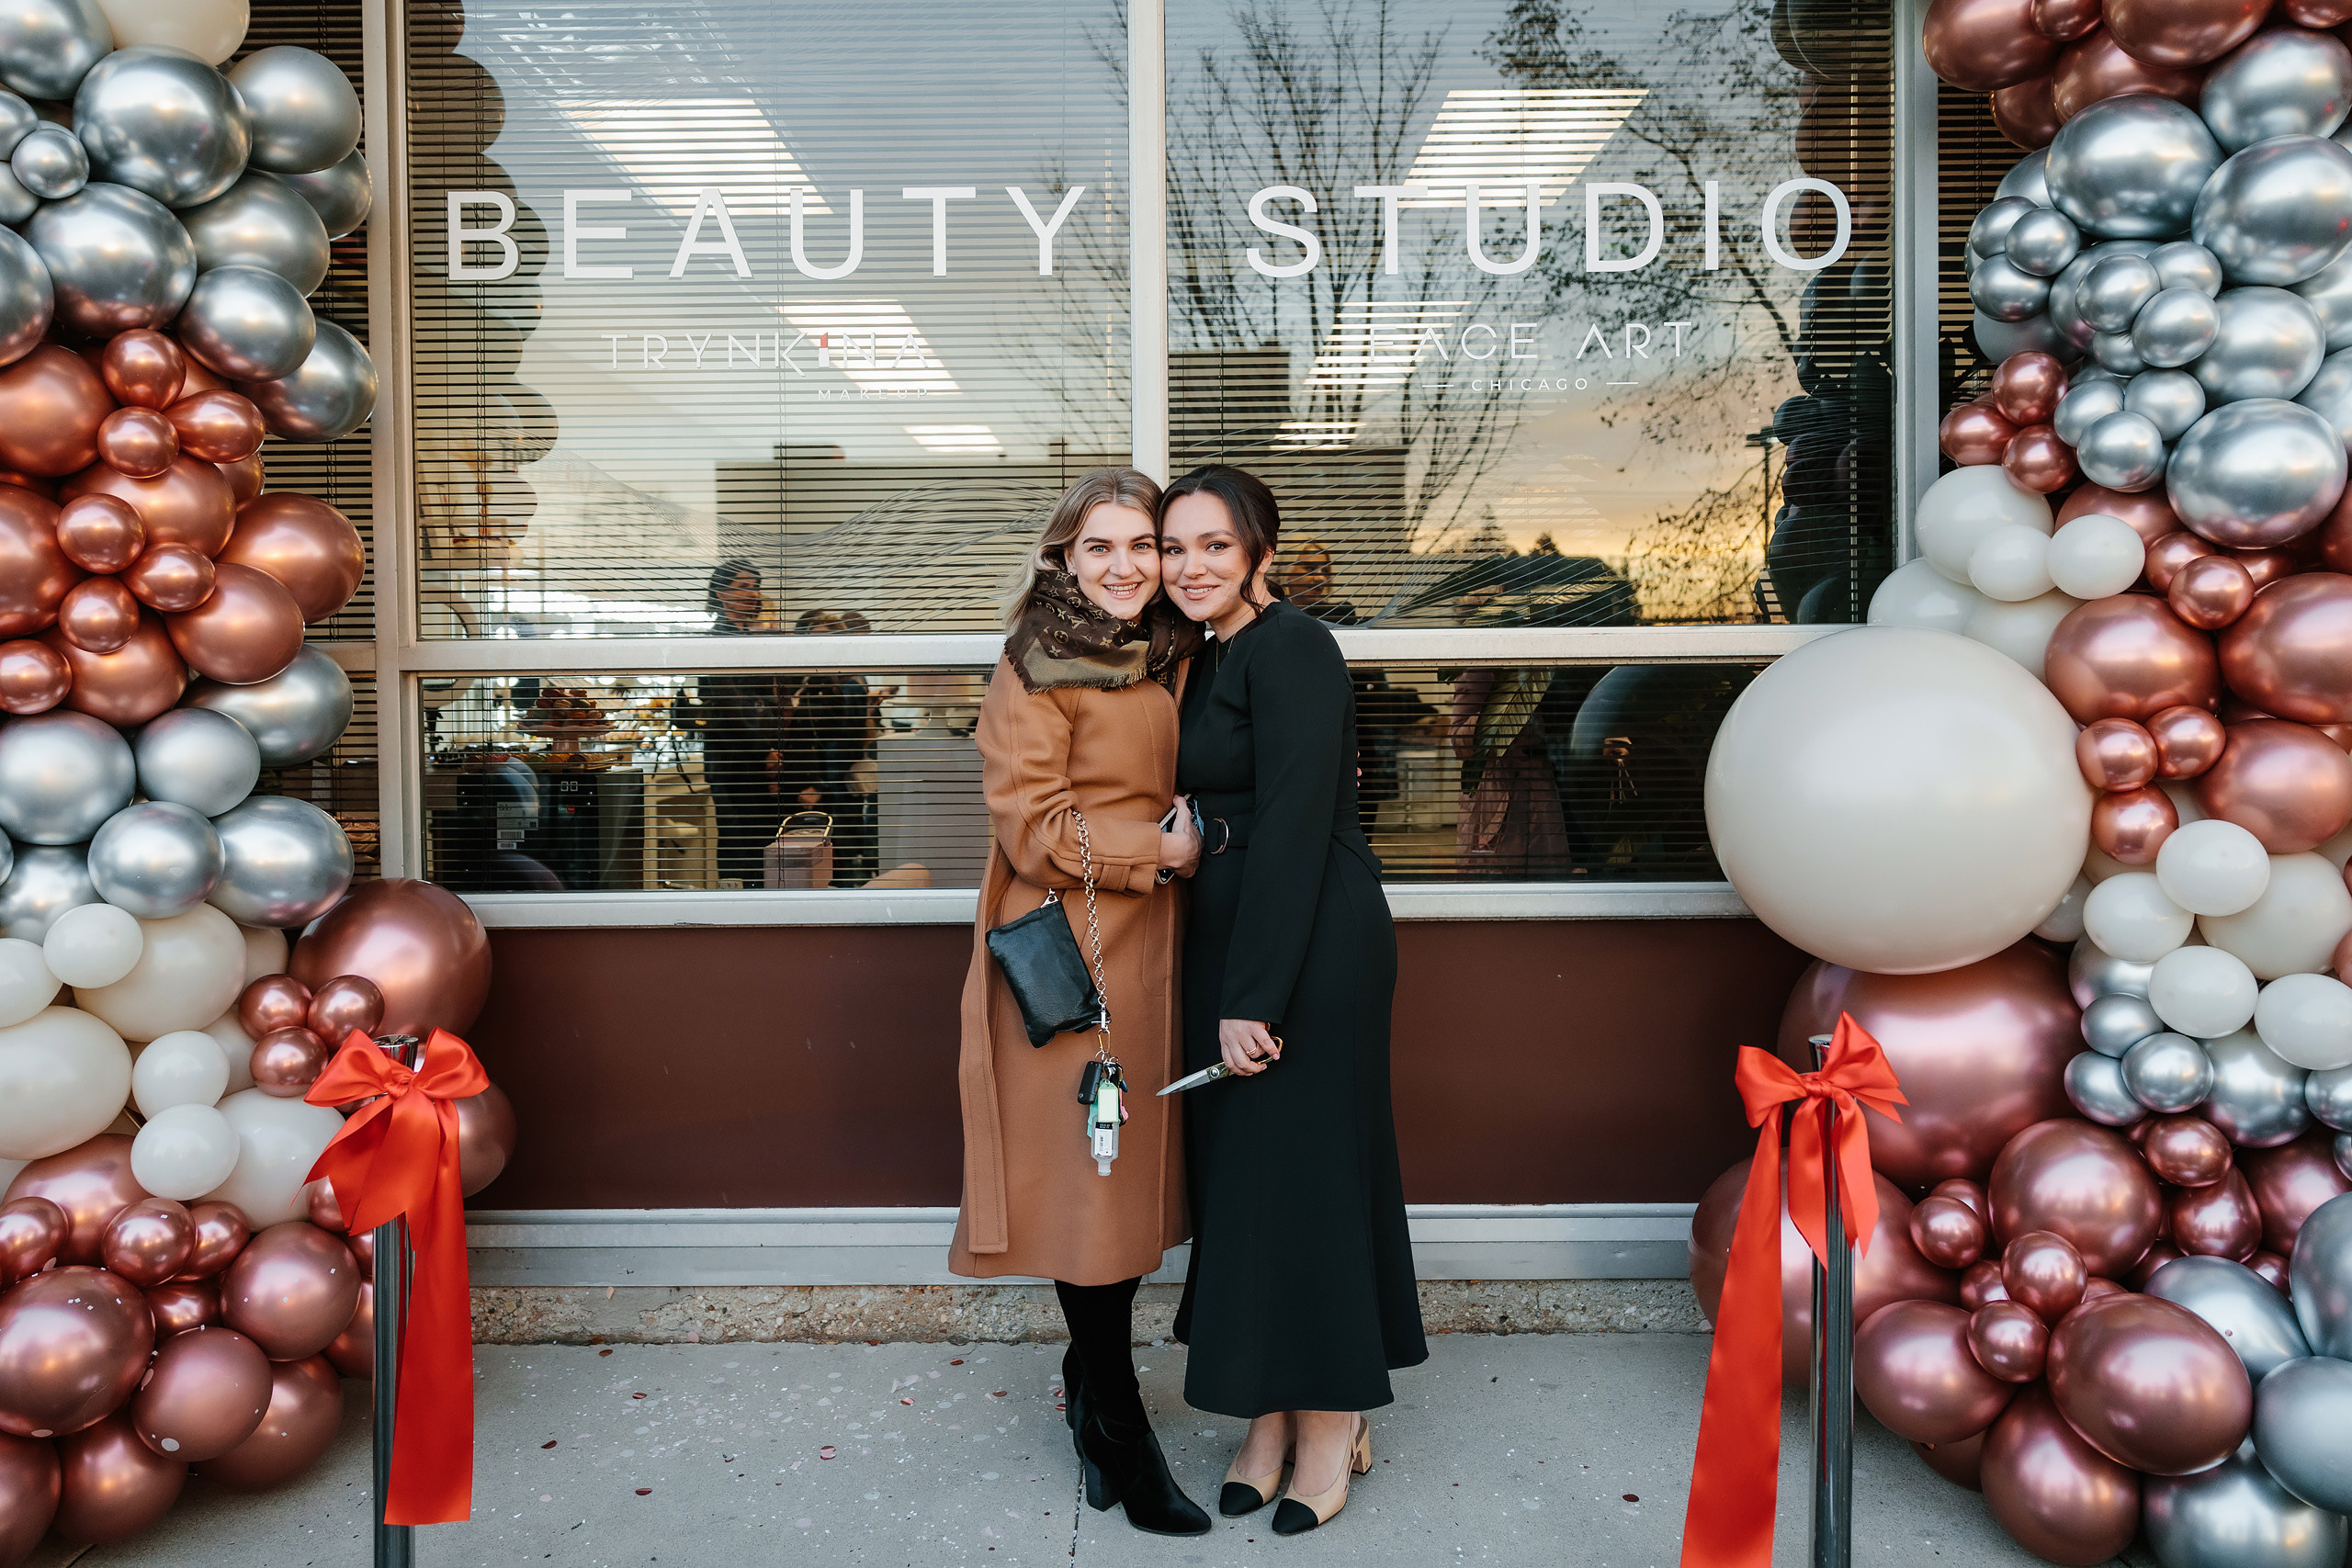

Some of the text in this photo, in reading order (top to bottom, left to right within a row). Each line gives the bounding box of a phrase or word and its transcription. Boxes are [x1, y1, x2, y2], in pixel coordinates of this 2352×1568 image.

[446, 177, 1852, 281] BEAUTY STUDIO
[600, 332, 929, 377] TRYNKINA
[1370, 321, 1692, 362] FACE ART
[818, 388, 928, 400] MAKEUP
[1471, 378, 1589, 391] CHICAGO
